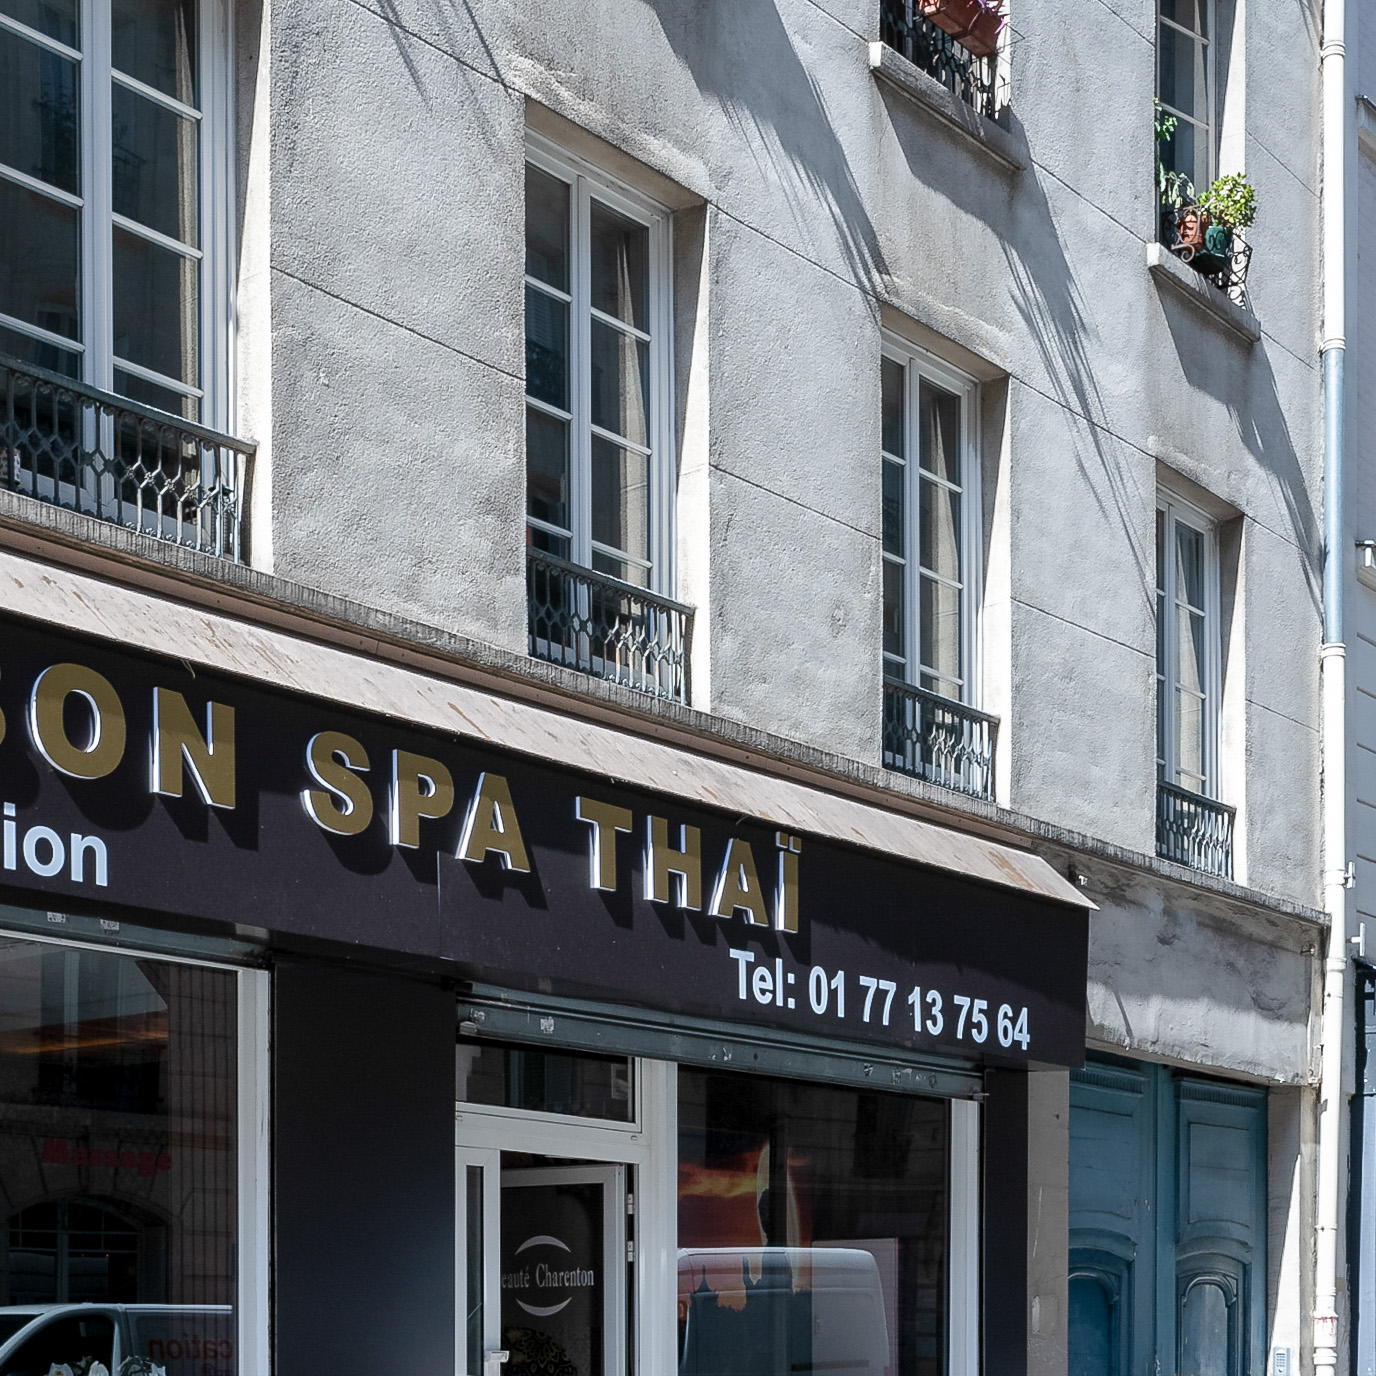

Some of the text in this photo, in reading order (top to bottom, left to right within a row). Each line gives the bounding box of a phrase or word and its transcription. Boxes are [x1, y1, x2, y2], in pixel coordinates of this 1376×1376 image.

[300, 730, 531, 873] SPA
[575, 795, 802, 934] THAÏ
[729, 948, 1031, 1051] Tel: 01 77 13 75 64
[42, 1138, 172, 1177] Massage
[501, 1263, 595, 1289] eauté Charenton
